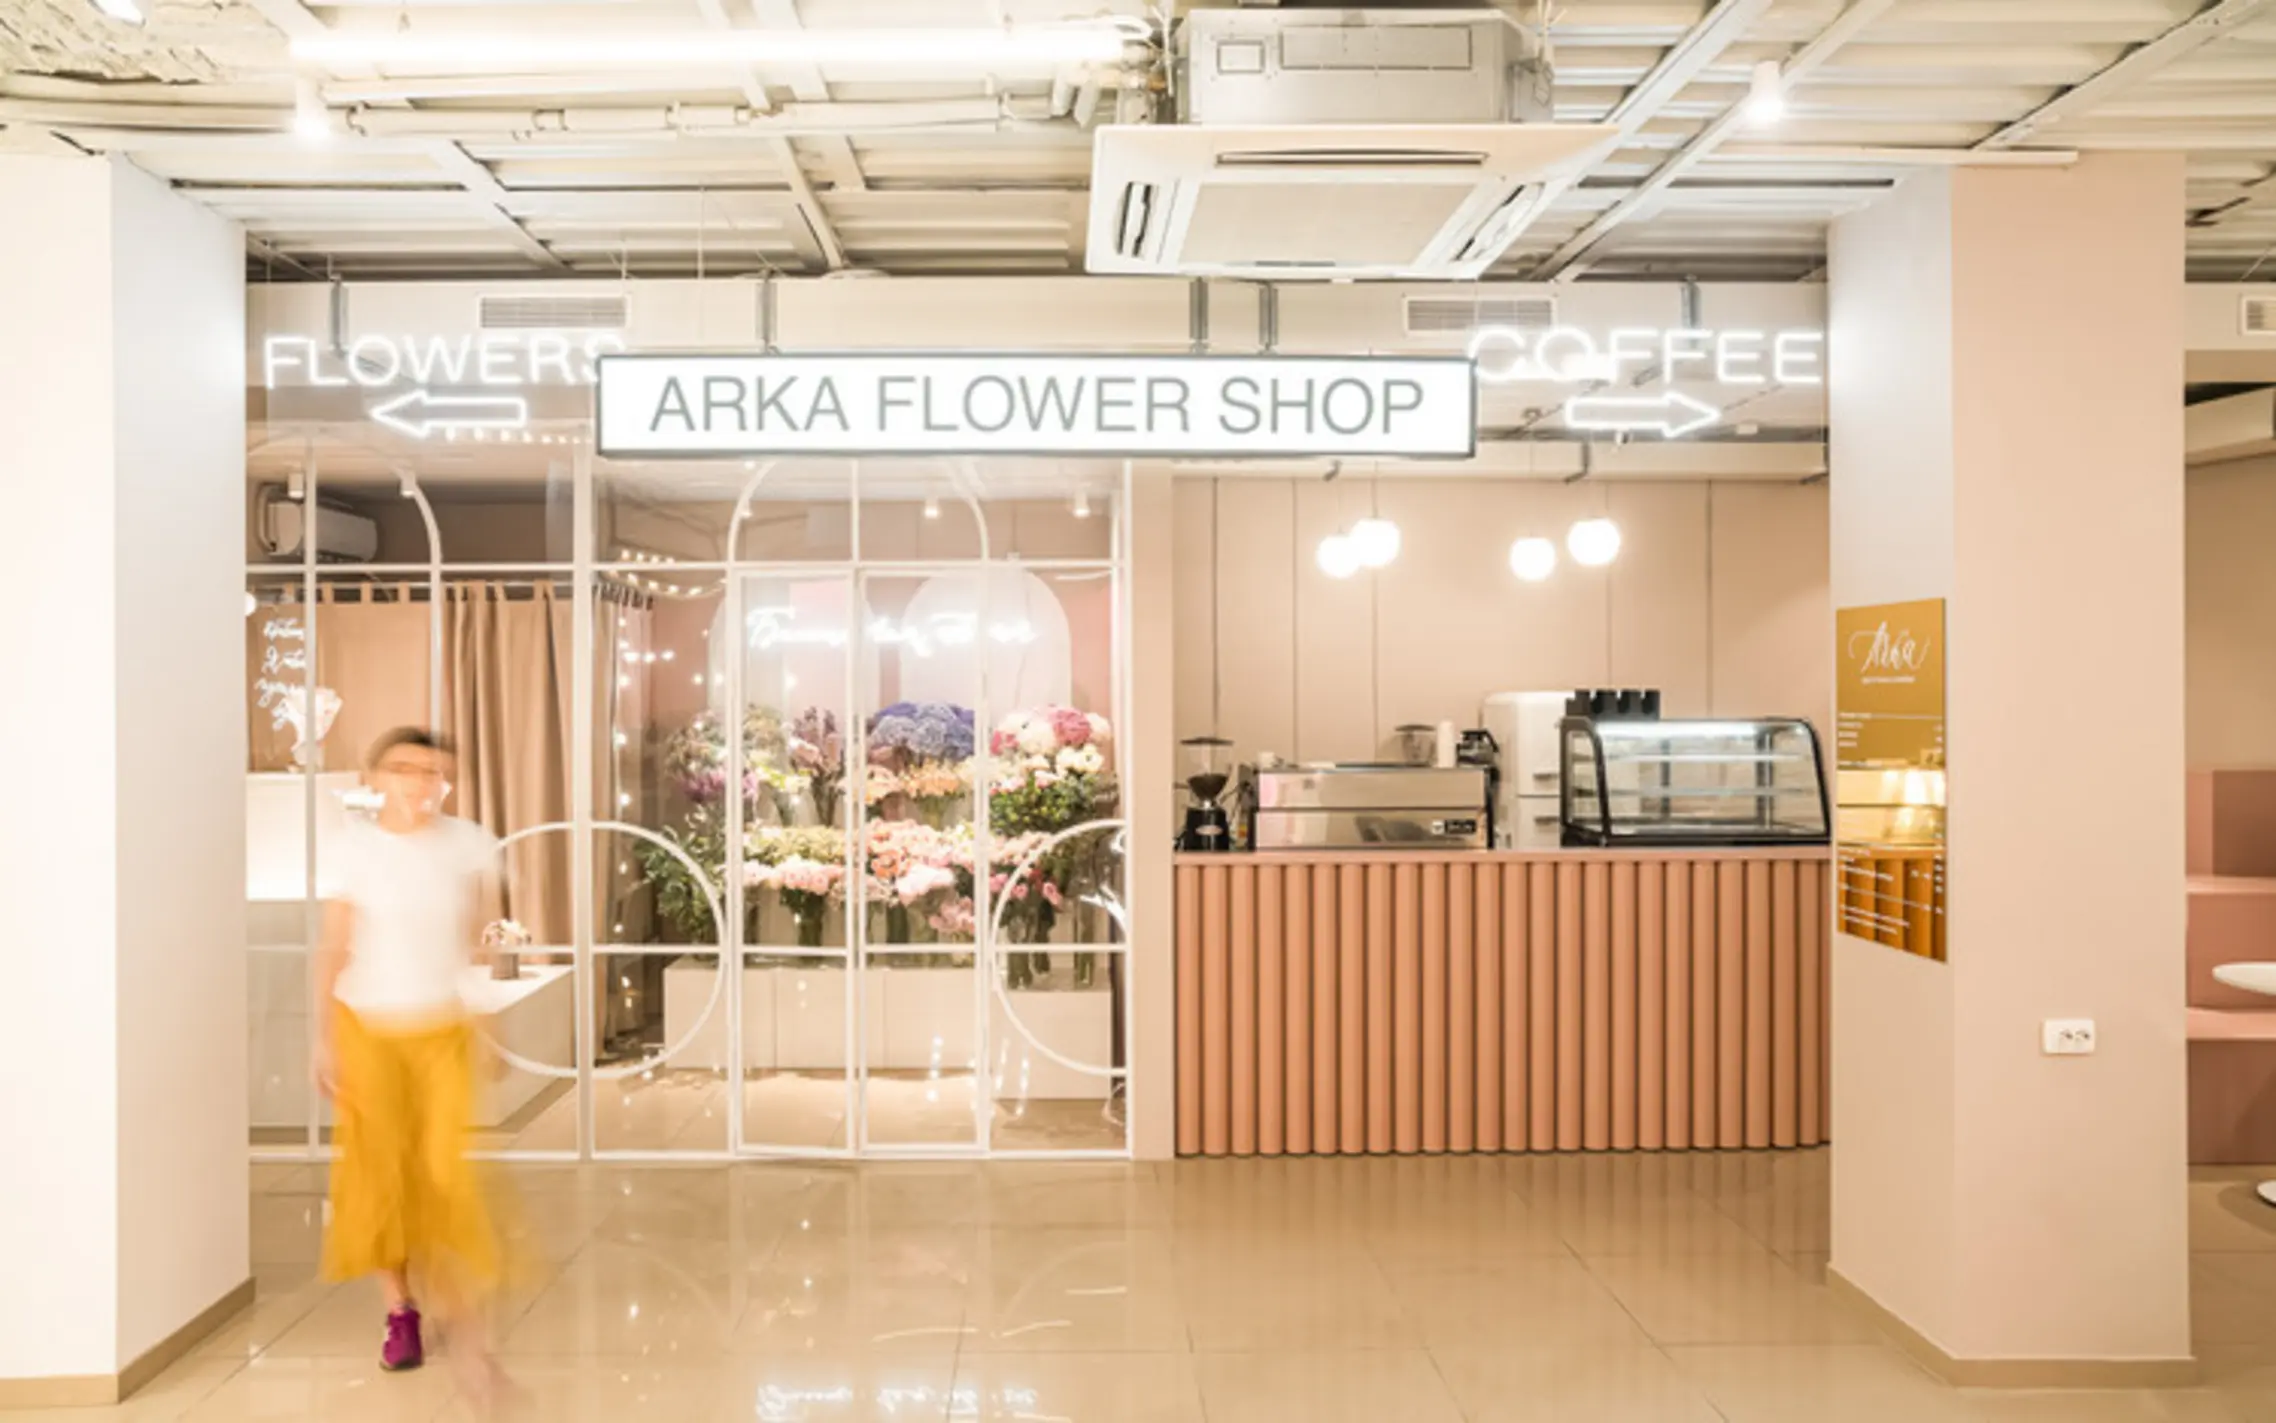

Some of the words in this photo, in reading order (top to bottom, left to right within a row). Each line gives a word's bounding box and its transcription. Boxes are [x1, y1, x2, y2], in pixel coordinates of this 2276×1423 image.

[1468, 326, 1824, 384] COFFEE
[648, 375, 851, 433] ARKA
[877, 374, 1194, 435] FLOWER
[1217, 376, 1425, 437] SHOP
